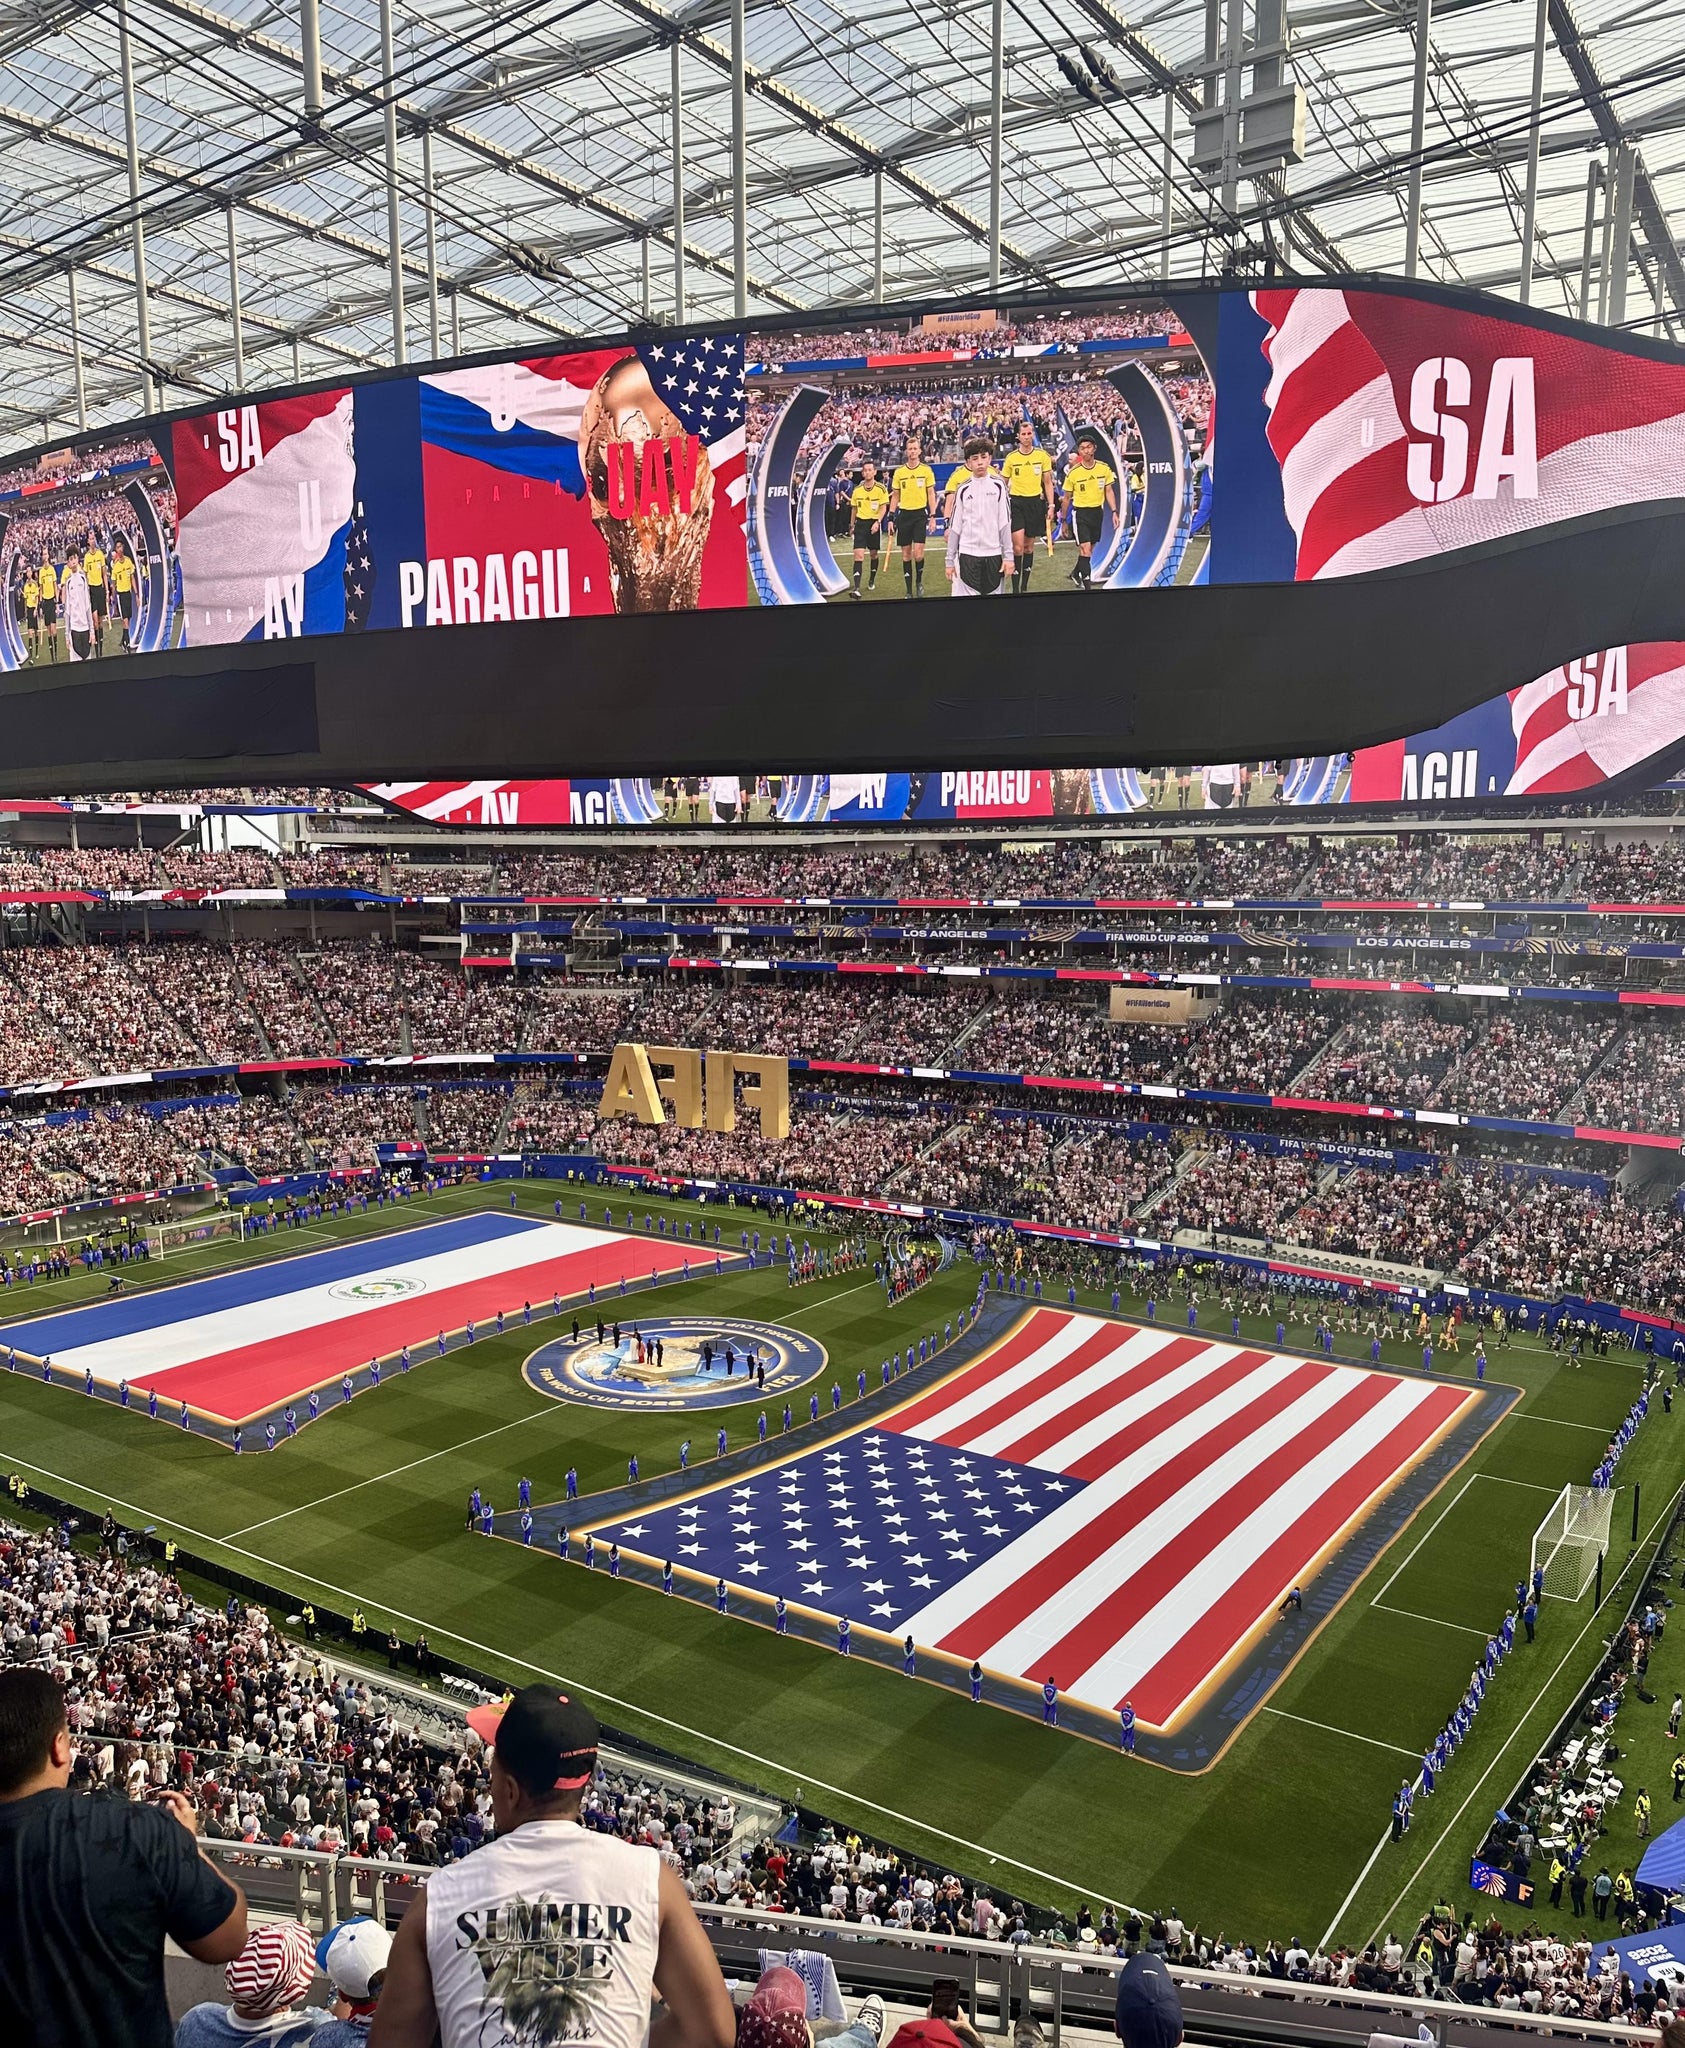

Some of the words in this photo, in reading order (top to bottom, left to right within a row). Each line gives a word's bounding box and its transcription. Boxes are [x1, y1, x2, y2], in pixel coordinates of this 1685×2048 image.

[1407, 357, 1539, 502] SA
[217, 405, 264, 473] SA
[1150, 462, 1172, 474] FIFA
[607, 435, 699, 520] UAY
[767, 486, 789, 498] FIFA
[813, 488, 826, 496] FIFA
[150, 555, 162, 564] FIFA
[400, 548, 571, 628] PARAGU
[858, 773, 888, 809] AY
[941, 770, 1031, 807] PARAGU
[903, 929, 927, 938] LOS
[929, 930, 988, 939] ANGELES
[1106, 933, 1125, 941] FIFA
[1125, 934, 1156, 942] WORLD
[1157, 935, 1177, 943] CUP
[1177, 935, 1210, 943] 2026
[1356, 937, 1389, 947] LOS
[1391, 938, 1472, 949] ANGELES
[1125, 999, 1171, 1009] #FIFAWorldCup
[1279, 1138, 1300, 1149] FIFA
[1336, 1145, 1356, 1154] CUP
[1357, 1147, 1395, 1159] 2026
[441, 1178, 457, 1187] FIFA
[549, 1378, 589, 1399] WORLD
[587, 1393, 620, 1404] CUP
[755, 1374, 802, 1393] FIFA
[1518, 1883, 1534, 1901] F
[455, 1903, 632, 1951] SUMMER
[1552, 1946, 1564, 1961] 26
[1626, 1943, 1668, 1961] 2026
[474, 1943, 614, 1984] VIBE
